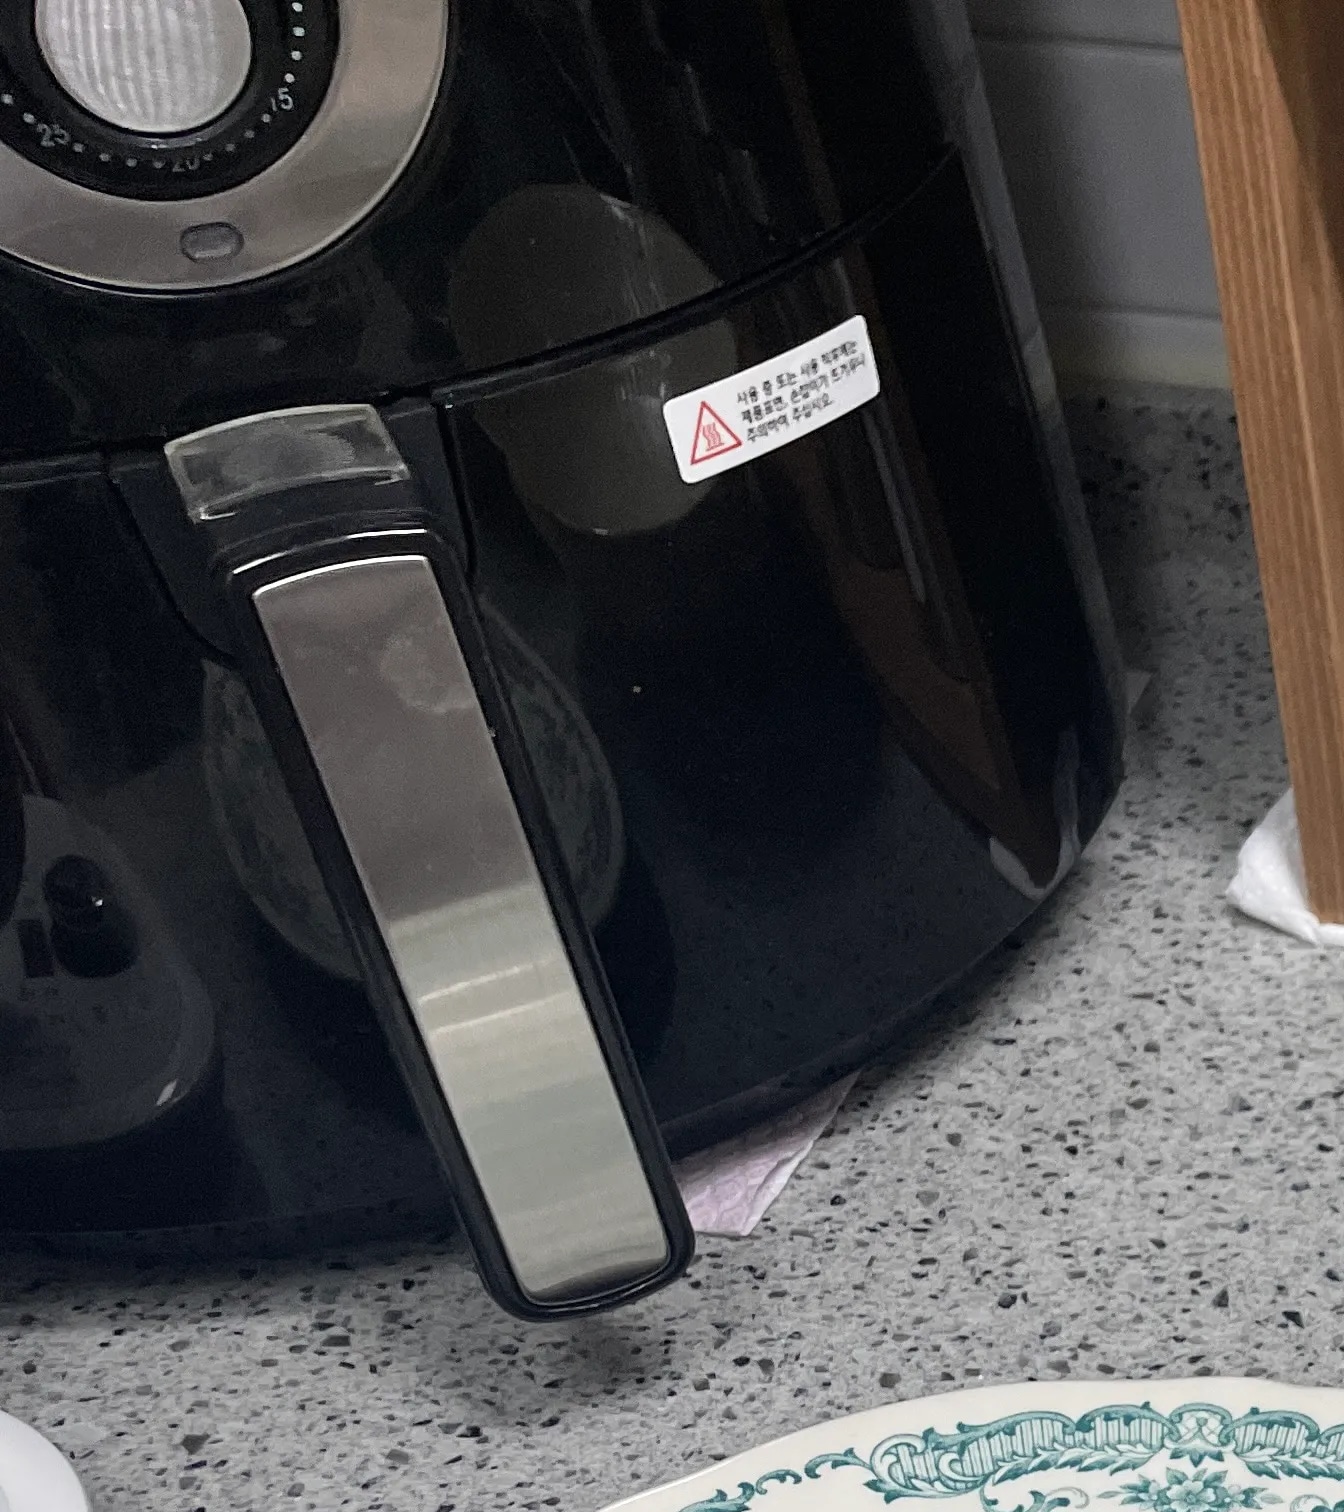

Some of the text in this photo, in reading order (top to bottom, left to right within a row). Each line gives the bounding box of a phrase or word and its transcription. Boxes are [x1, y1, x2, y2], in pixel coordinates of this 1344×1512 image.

[271, 88, 295, 113] 15
[737, 386, 758, 404] 사용
[762, 380, 773, 397] 중
[776, 371, 798, 390] 또는
[800, 358, 819, 377] 사용
[747, 414, 790, 442] 주의하여
